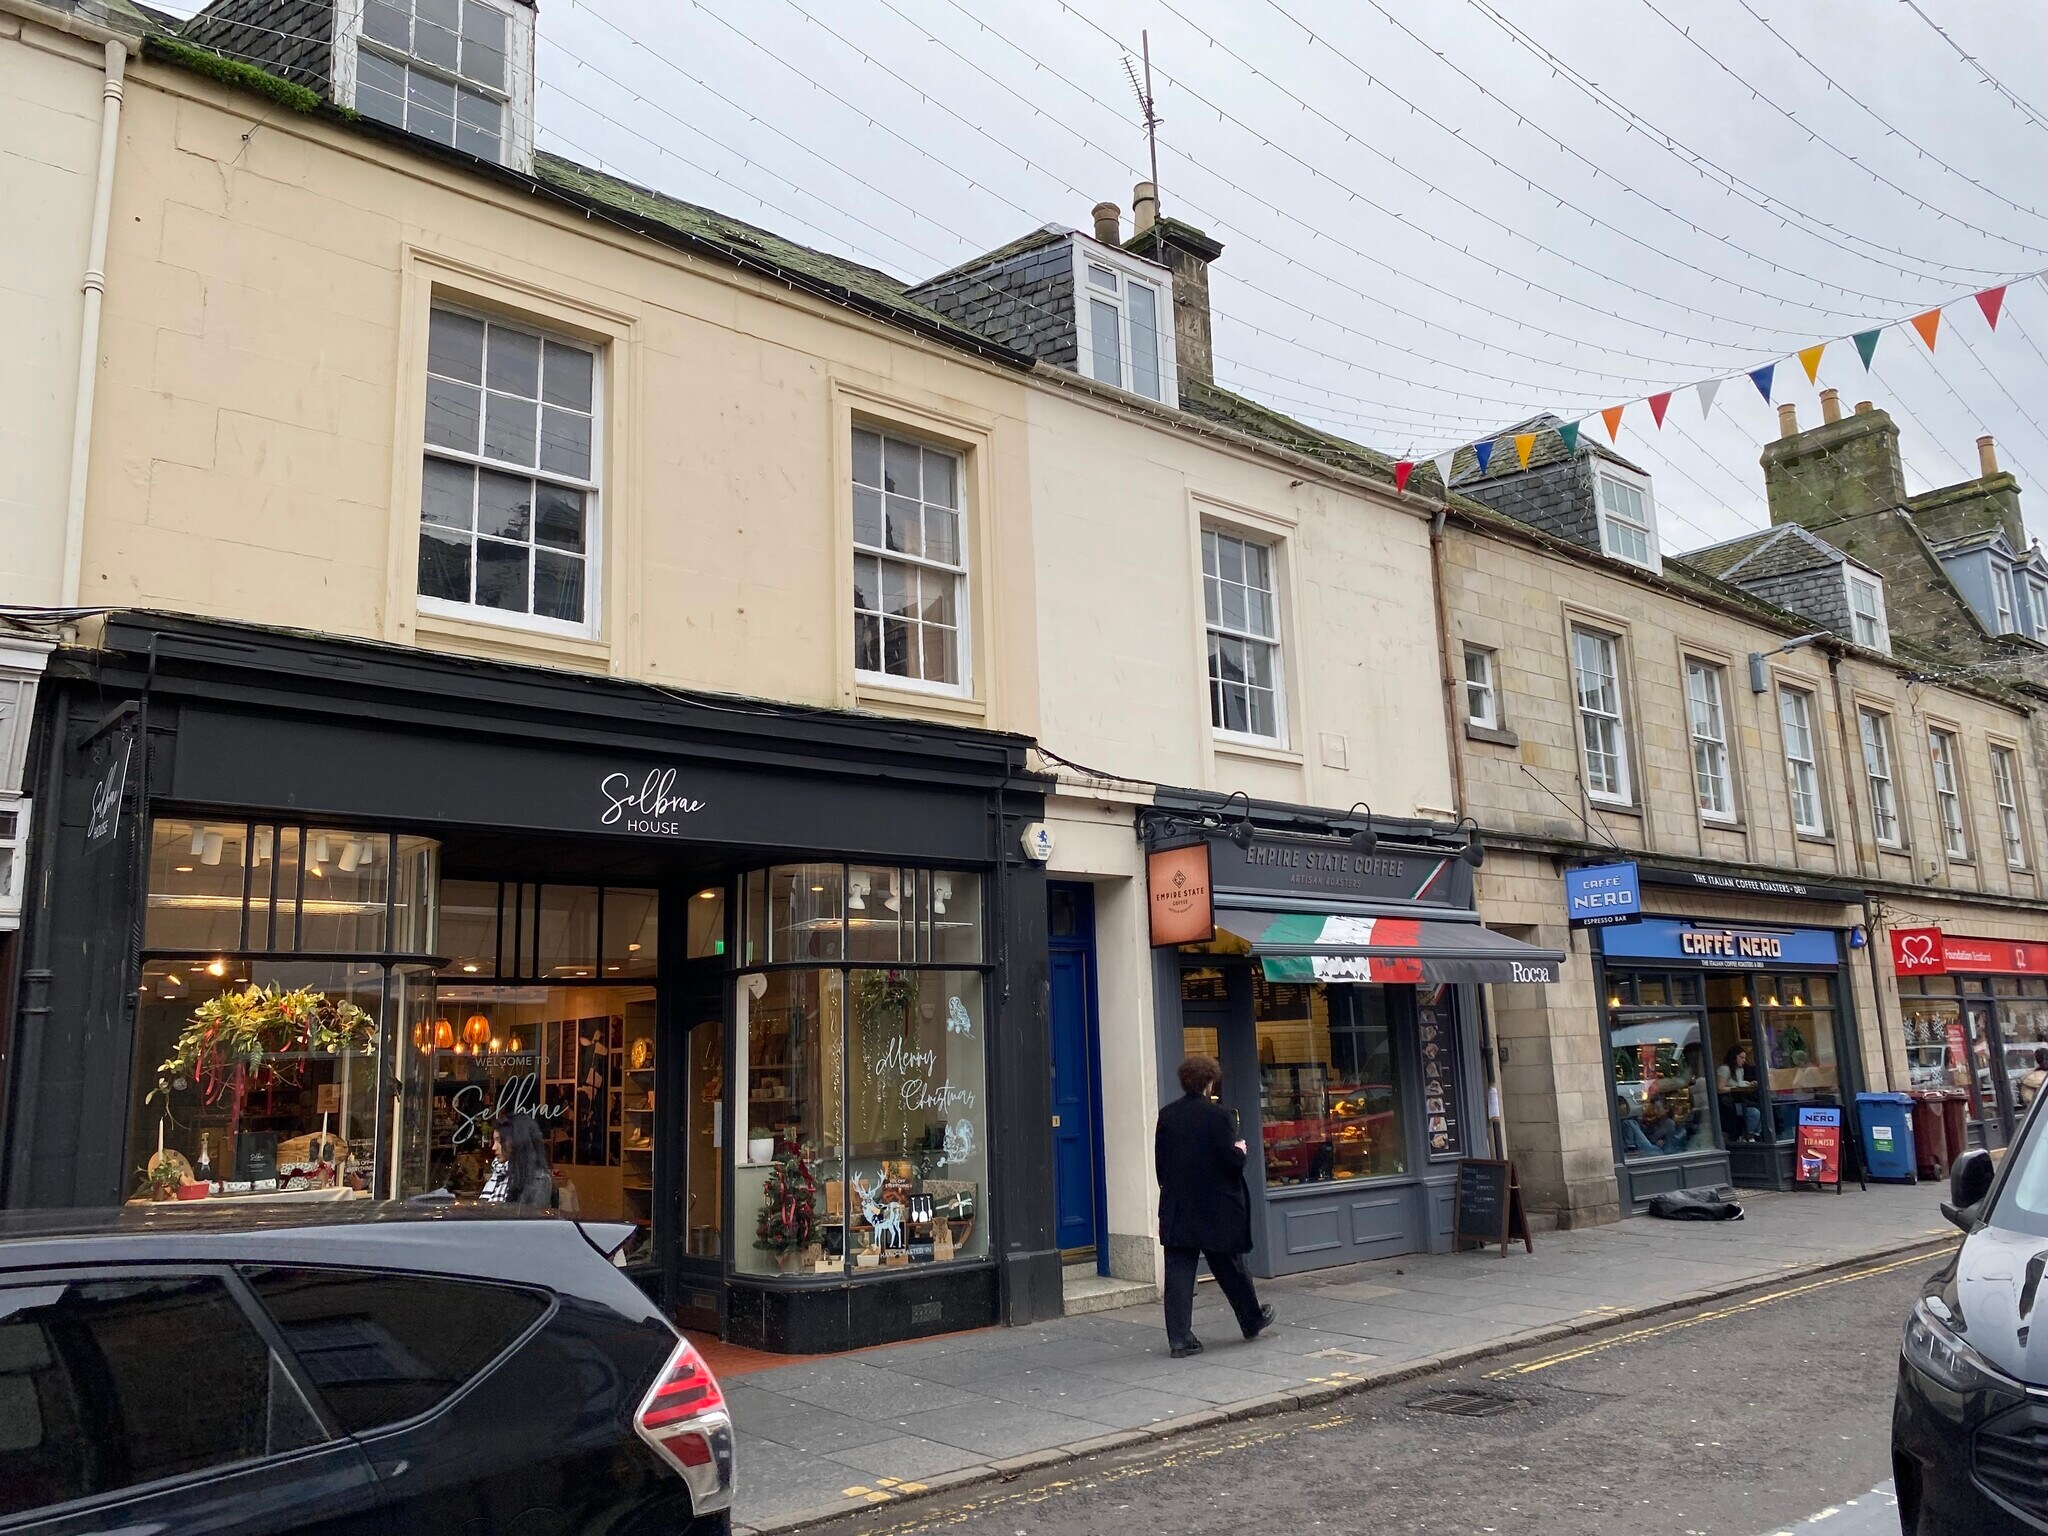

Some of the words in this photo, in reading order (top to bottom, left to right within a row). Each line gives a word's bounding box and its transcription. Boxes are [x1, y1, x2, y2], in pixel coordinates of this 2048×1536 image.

[601, 768, 706, 825] Selbrae
[627, 820, 679, 835] HOUSE
[1246, 846, 1299, 868] EMPIRE
[1306, 851, 1348, 872] STATE
[1353, 856, 1404, 878] COFFEE
[1290, 874, 1323, 886] ARTISAN
[1325, 877, 1362, 889] ROASTERS
[1583, 875, 1621, 889] CAFFÈ
[1693, 874, 1707, 884] THE
[1708, 876, 1735, 888] ITALIAN
[1736, 879, 1760, 890] COFFEE
[1760, 882, 1790, 893] ROASTERS
[1794, 886, 1807, 894] DELI
[1156, 890, 1181, 901] EMPIRE
[1183, 887, 1204, 897] STATE
[1574, 890, 1632, 909] NERO
[1583, 917, 1613, 926] ESPRESSO
[1682, 930, 1735, 955] CAFFÈ
[1739, 937, 1782, 957] NERO
[1945, 949, 1973, 961] Foundation
[1973, 951, 1992, 962] Scotland
[475, 1056, 532, 1067] WELCOME
[535, 1055, 550, 1066] TO
[876, 1035, 937, 1077] Merry
[901, 1079, 976, 1114] Christmas
[452, 1072, 569, 1145] Selbrae
